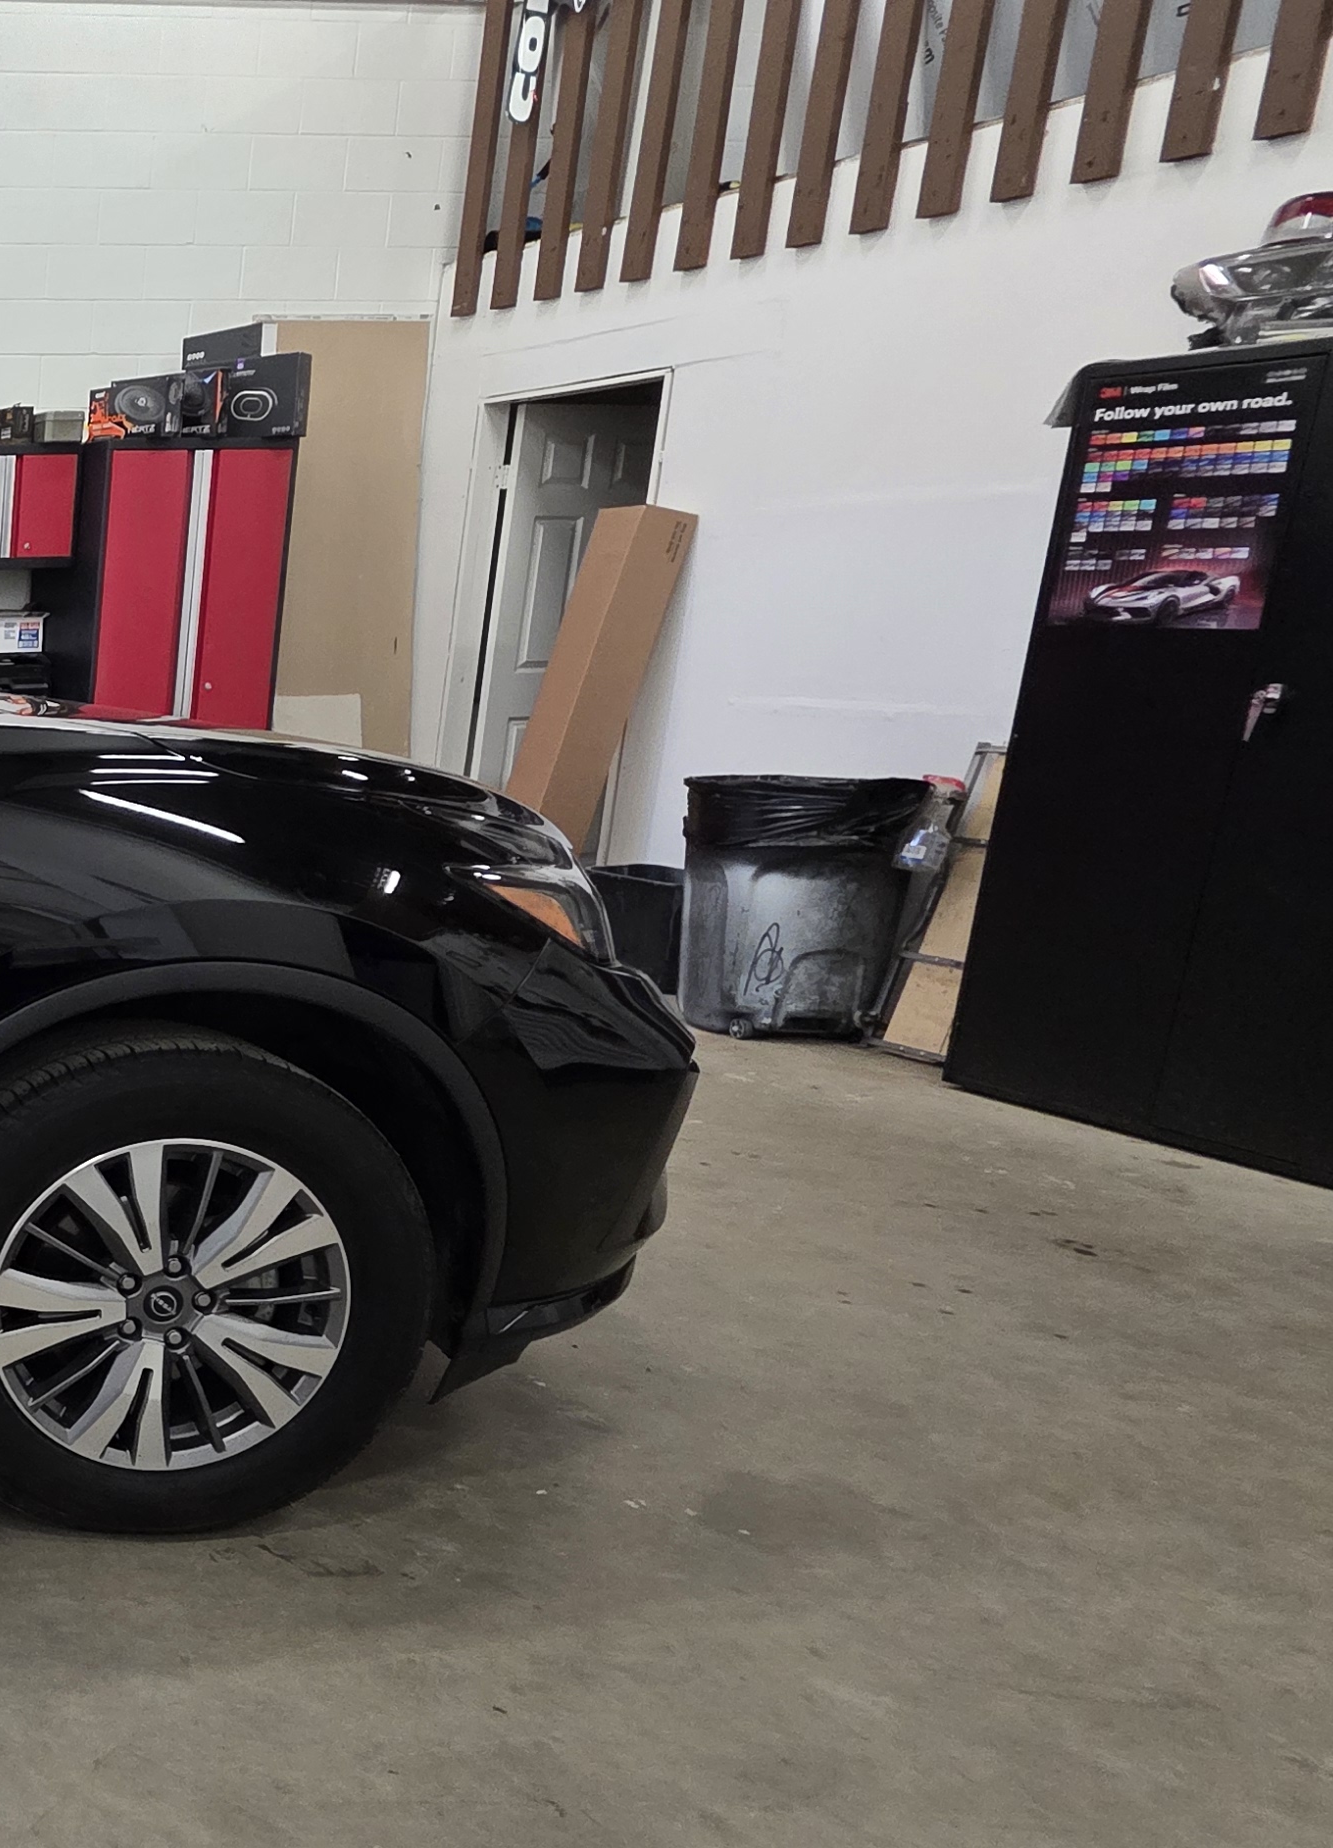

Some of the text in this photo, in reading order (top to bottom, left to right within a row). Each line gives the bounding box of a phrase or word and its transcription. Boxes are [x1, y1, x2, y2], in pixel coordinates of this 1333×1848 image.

[1094, 392, 1293, 422] Follow your own road.
